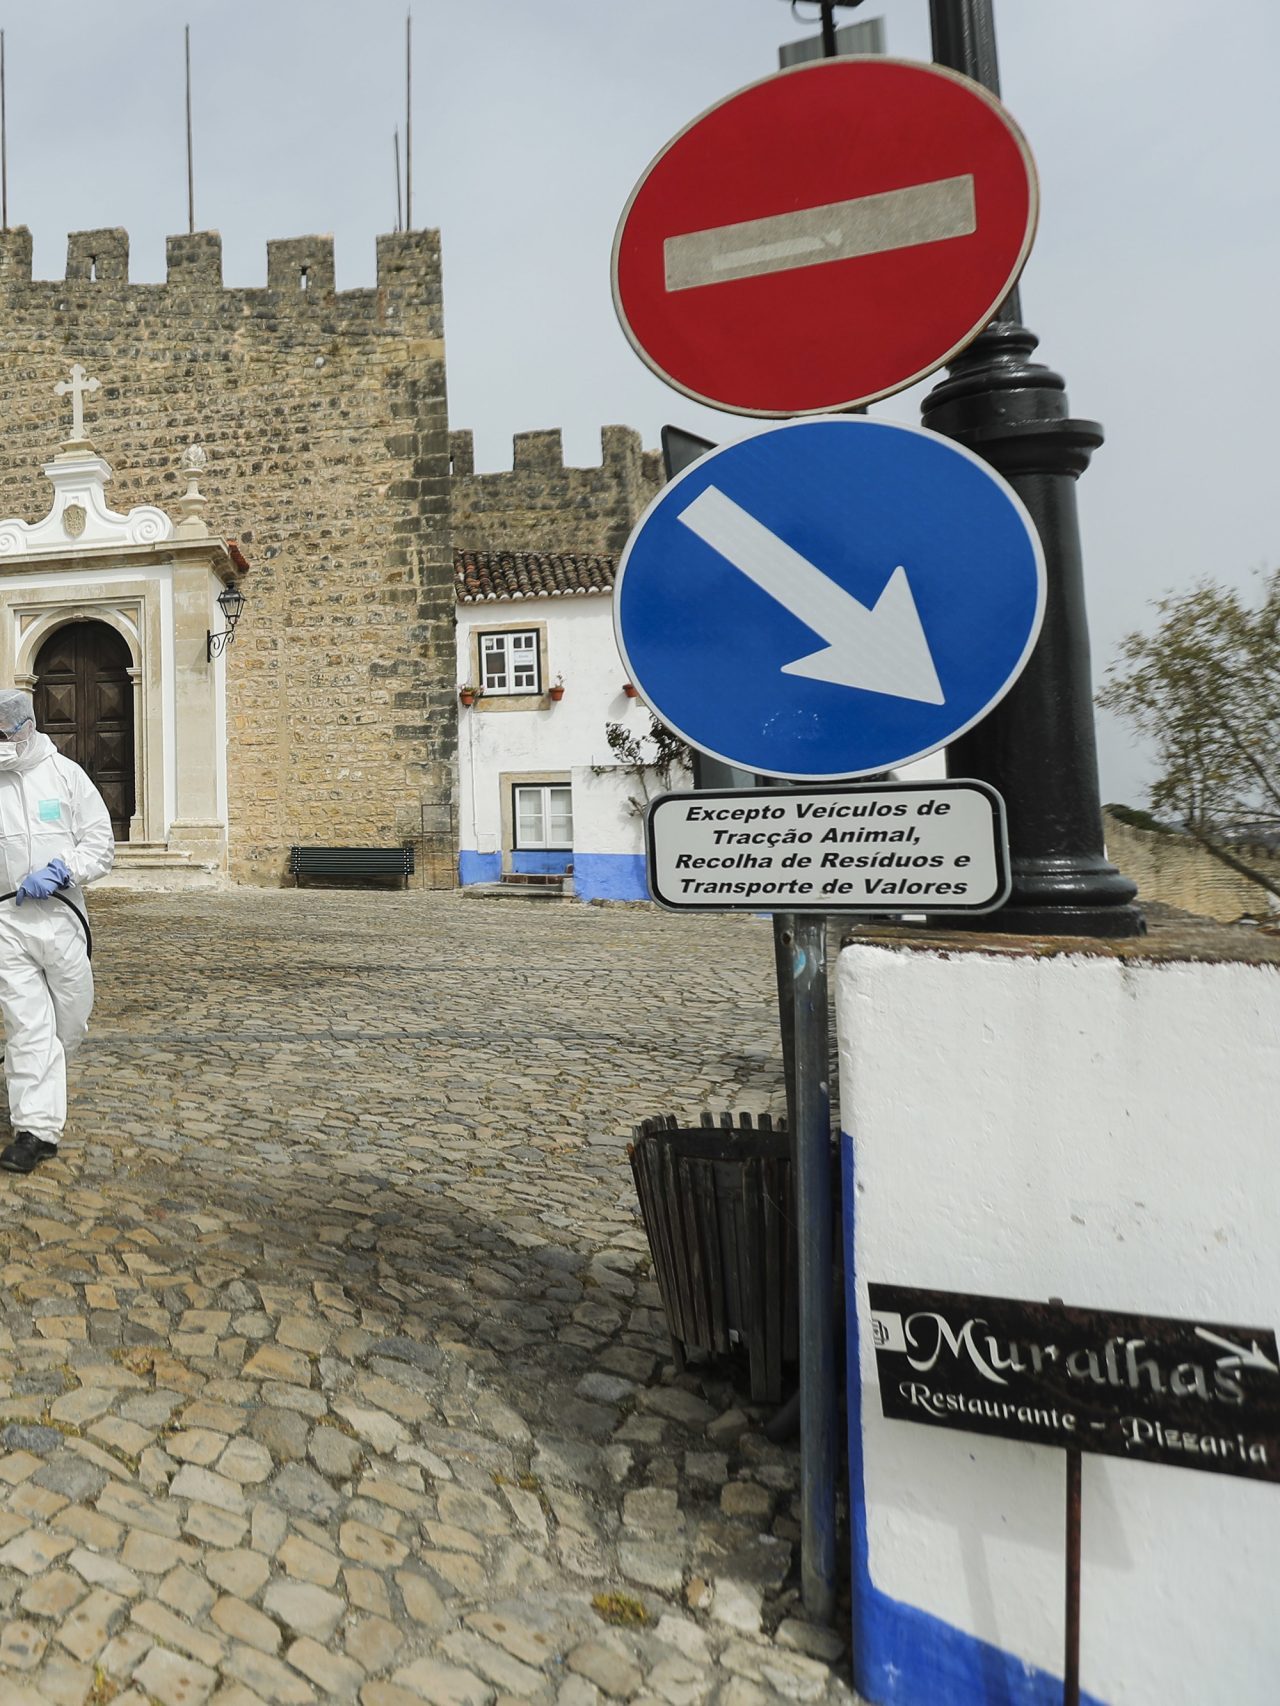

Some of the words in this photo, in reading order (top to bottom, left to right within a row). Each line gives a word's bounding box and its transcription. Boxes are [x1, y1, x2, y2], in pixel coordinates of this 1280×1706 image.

[686, 805, 786, 823] Excepto
[796, 801, 908, 819] Veículos
[917, 799, 951, 816] de
[713, 828, 813, 848] Tracção
[820, 826, 921, 845] Animal,
[675, 853, 772, 869] Recolha
[781, 853, 812, 868] de
[820, 851, 944, 868] Resíduos
[953, 854, 971, 868] e
[680, 878, 813, 897] Transporte
[821, 878, 853, 894] de
[864, 878, 968, 895] Valores
[904, 1311, 1245, 1405] Muralhas
[899, 1381, 1076, 1431] Restaurante
[1120, 1416, 1268, 1465] Pizzaria
